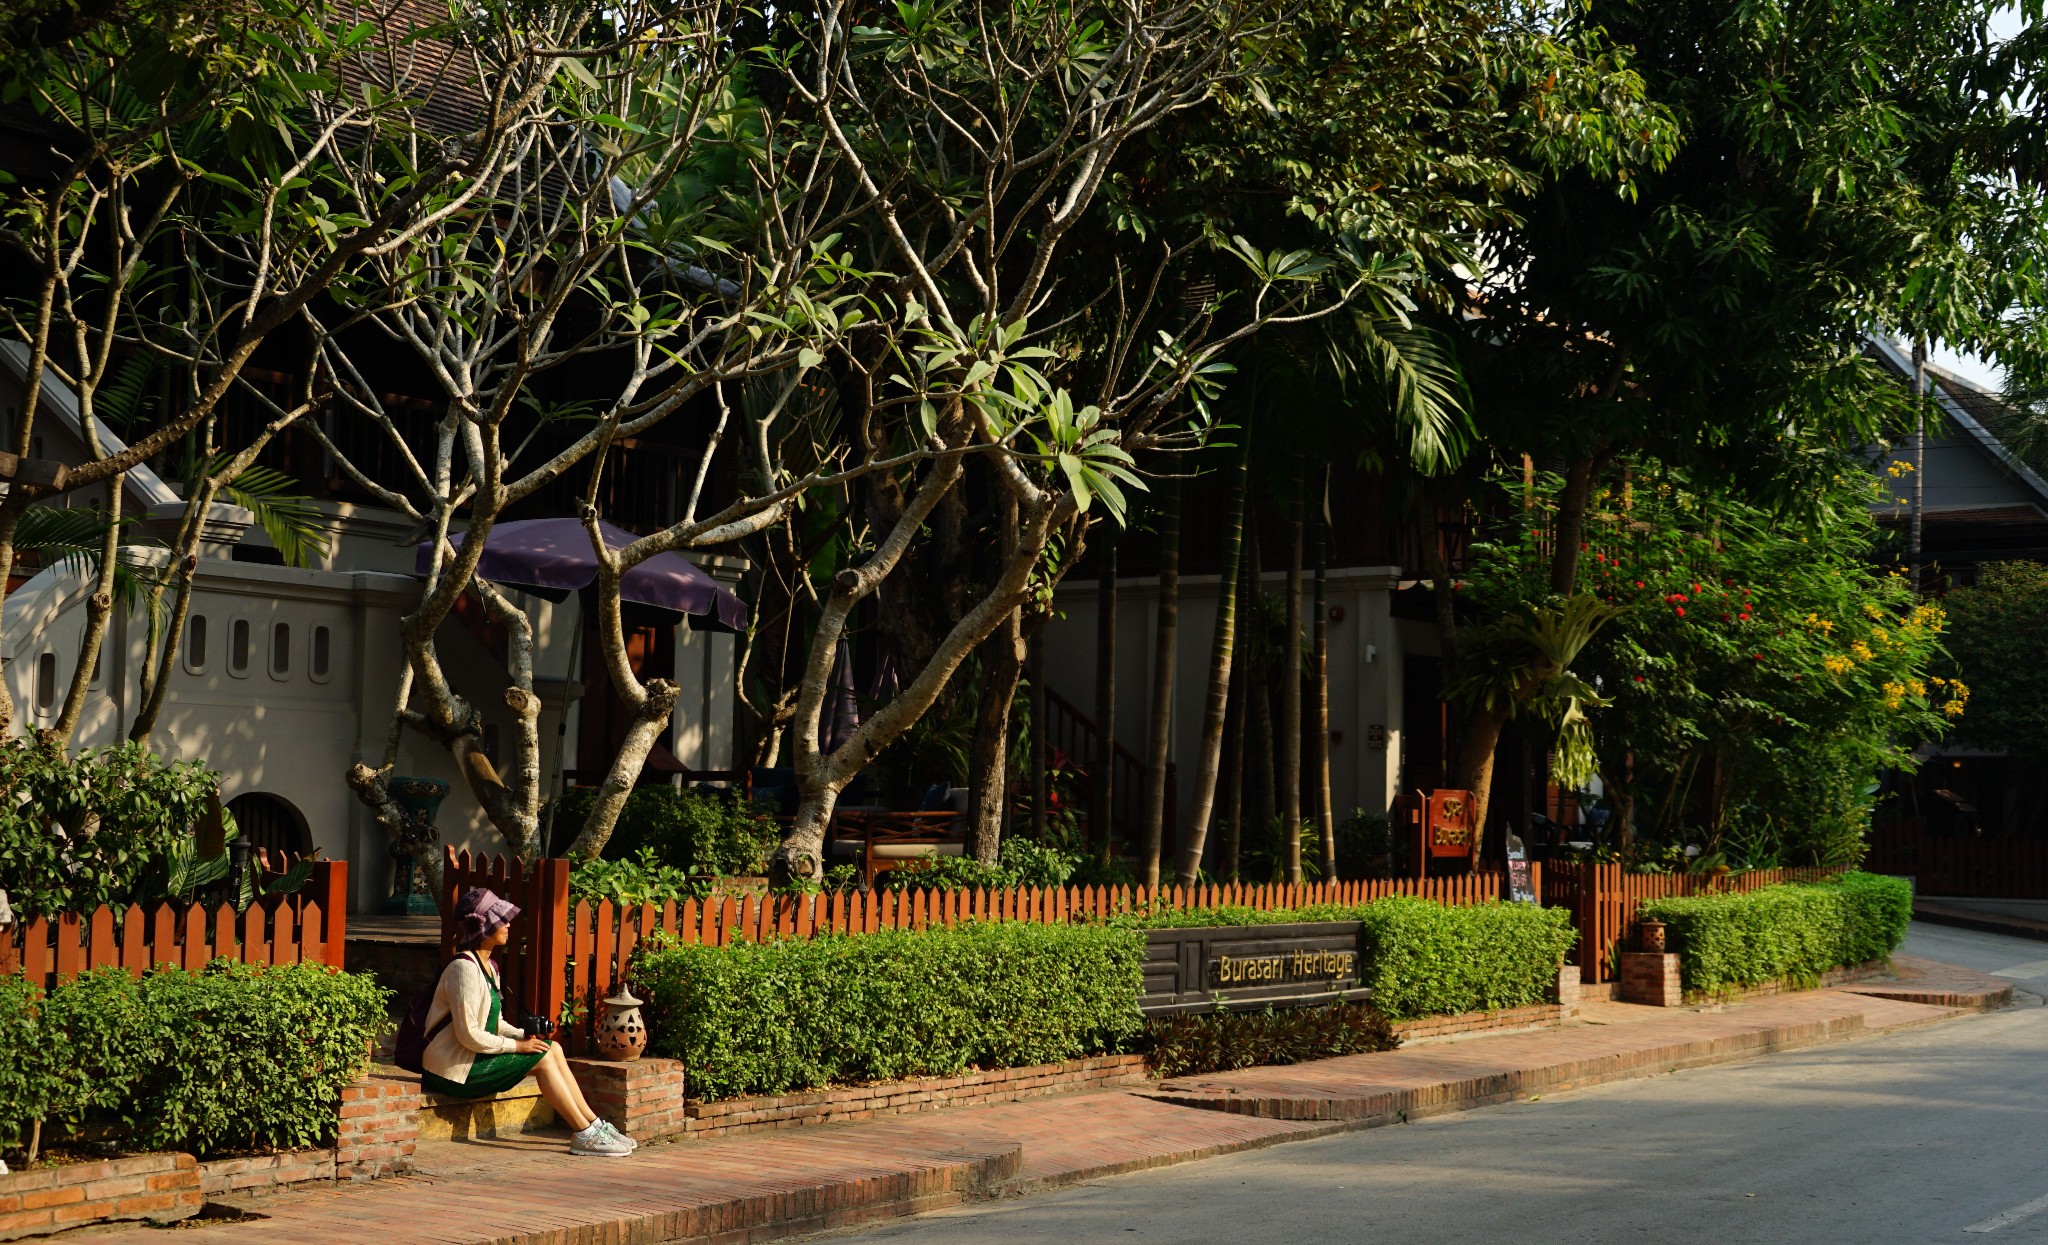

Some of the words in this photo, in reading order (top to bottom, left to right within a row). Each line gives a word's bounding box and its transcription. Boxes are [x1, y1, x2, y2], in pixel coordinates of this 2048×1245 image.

[1443, 797, 1463, 821] Spa
[1220, 955, 1283, 982] Burasari
[1293, 949, 1353, 980] Heritage
